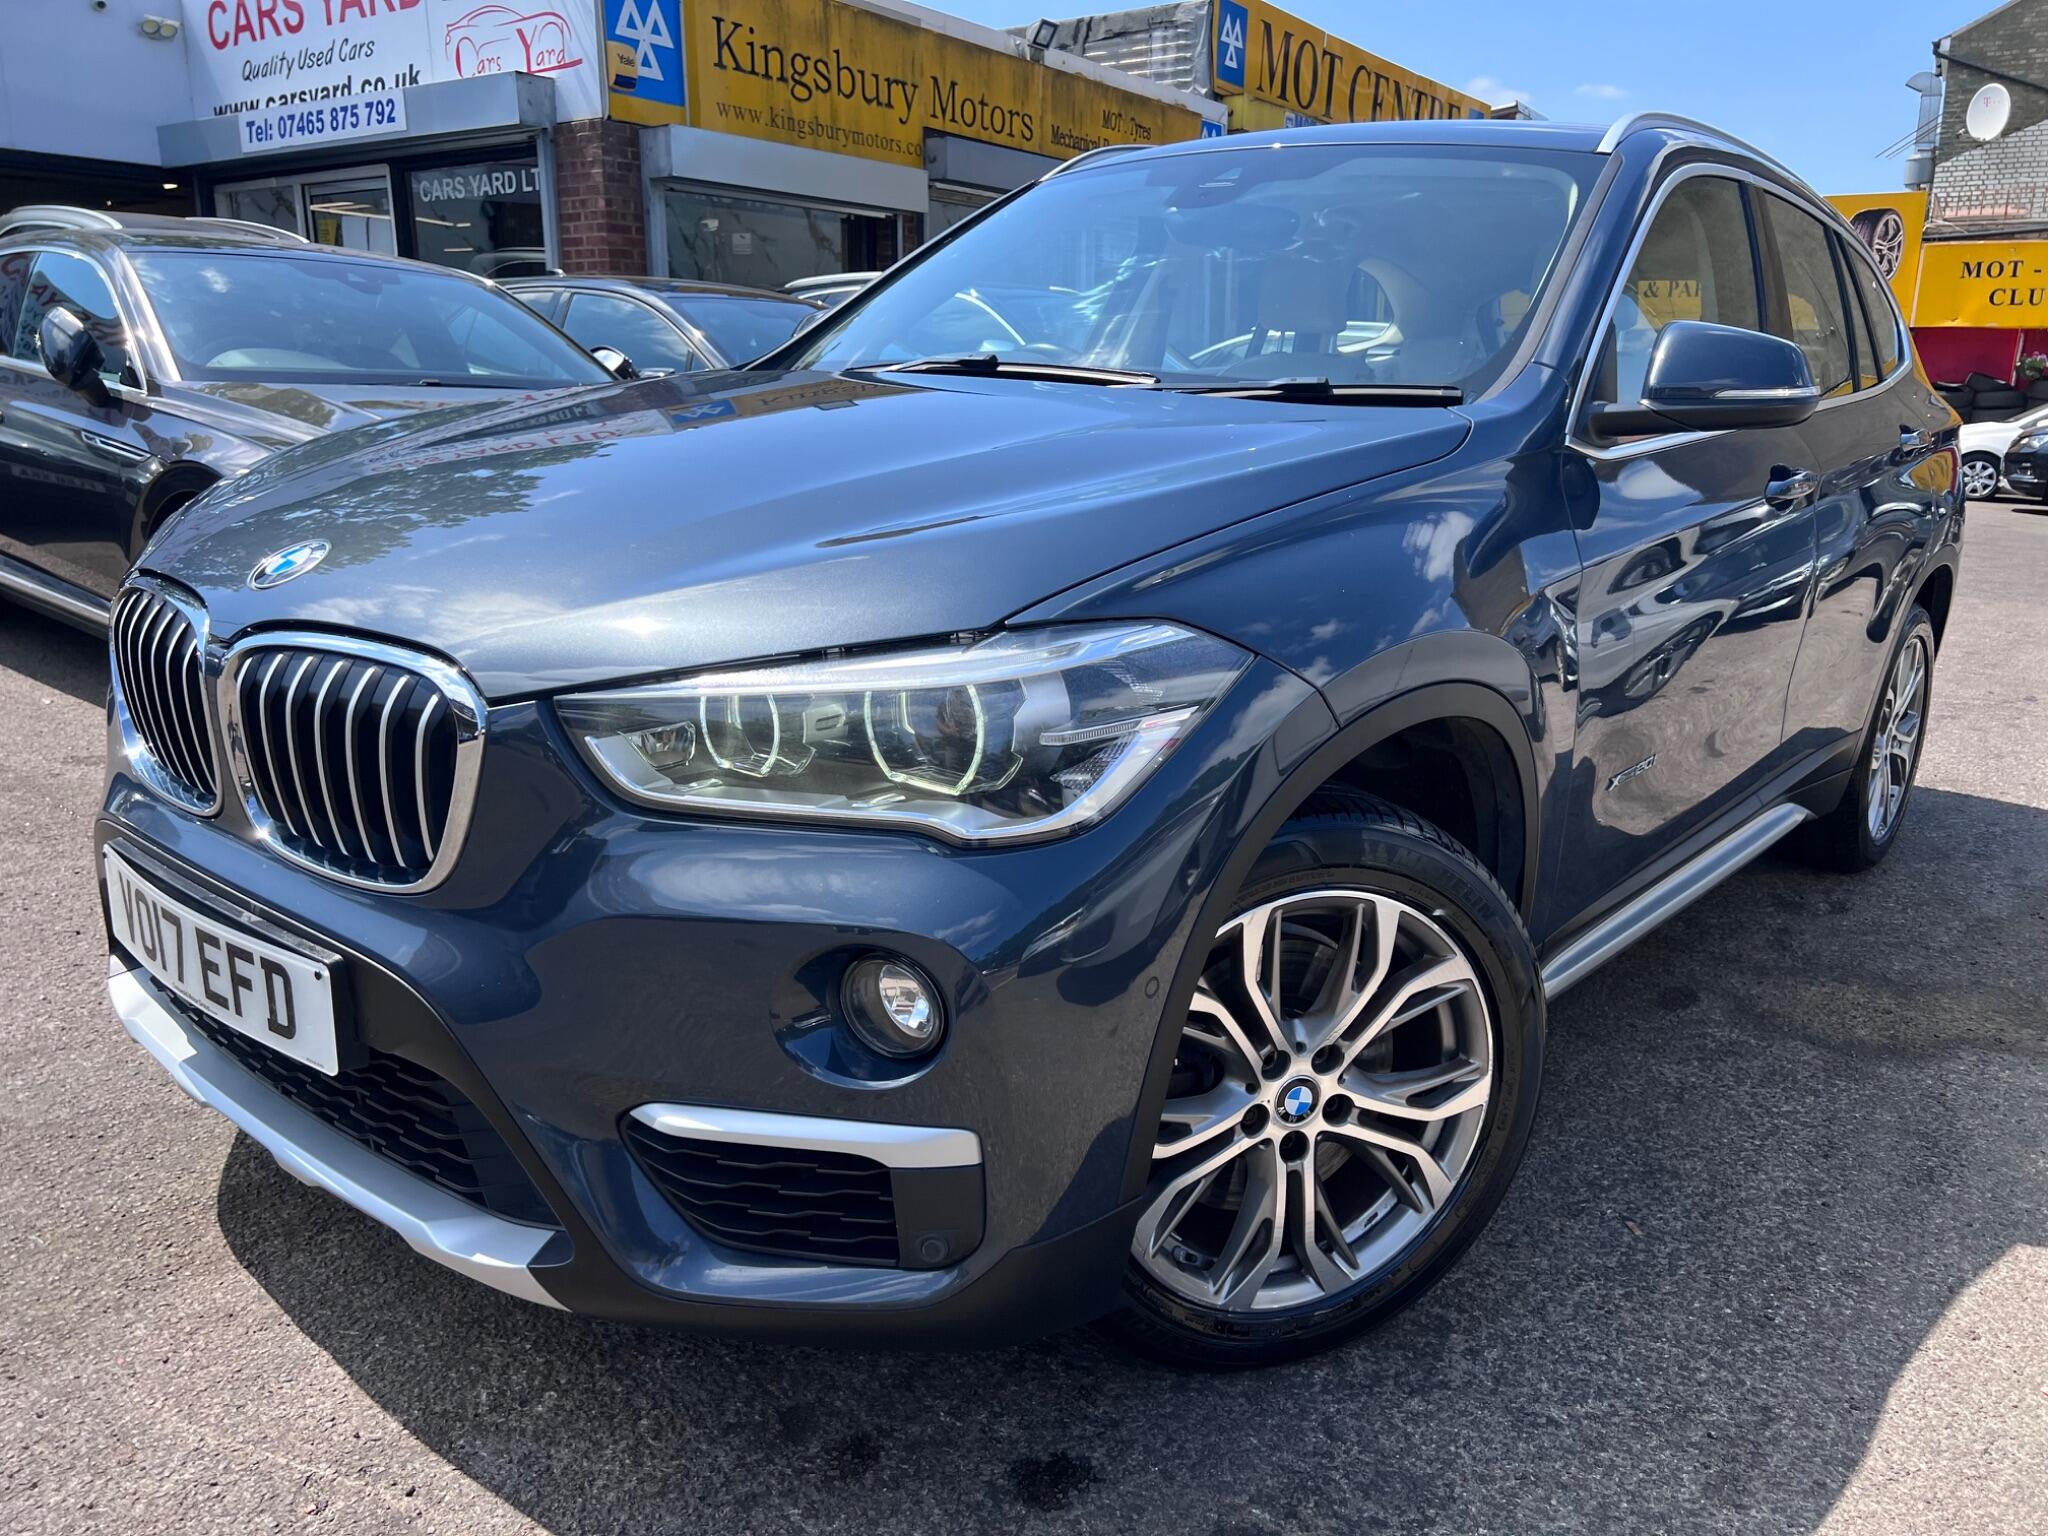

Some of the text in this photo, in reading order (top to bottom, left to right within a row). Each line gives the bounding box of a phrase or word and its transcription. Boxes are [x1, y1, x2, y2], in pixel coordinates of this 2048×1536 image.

[208, 0, 305, 50] CARS
[242, 37, 376, 80] Quality Used Cars
[712, 16, 1033, 142] Kingsbury Motors
[1257, 19, 1343, 118] MOT
[213, 63, 421, 117] wwwcarsyard.co.uk
[246, 98, 396, 144] Tel: 07465 875 792
[1101, 109, 1122, 133] MOT
[1129, 116, 1152, 142] Tyres
[419, 176, 466, 202] CARS
[468, 170, 517, 197] YARD
[1960, 260, 2025, 279] MOT
[1988, 287, 2046, 306] CLU
[118, 870, 297, 1041] VO17 EFD
